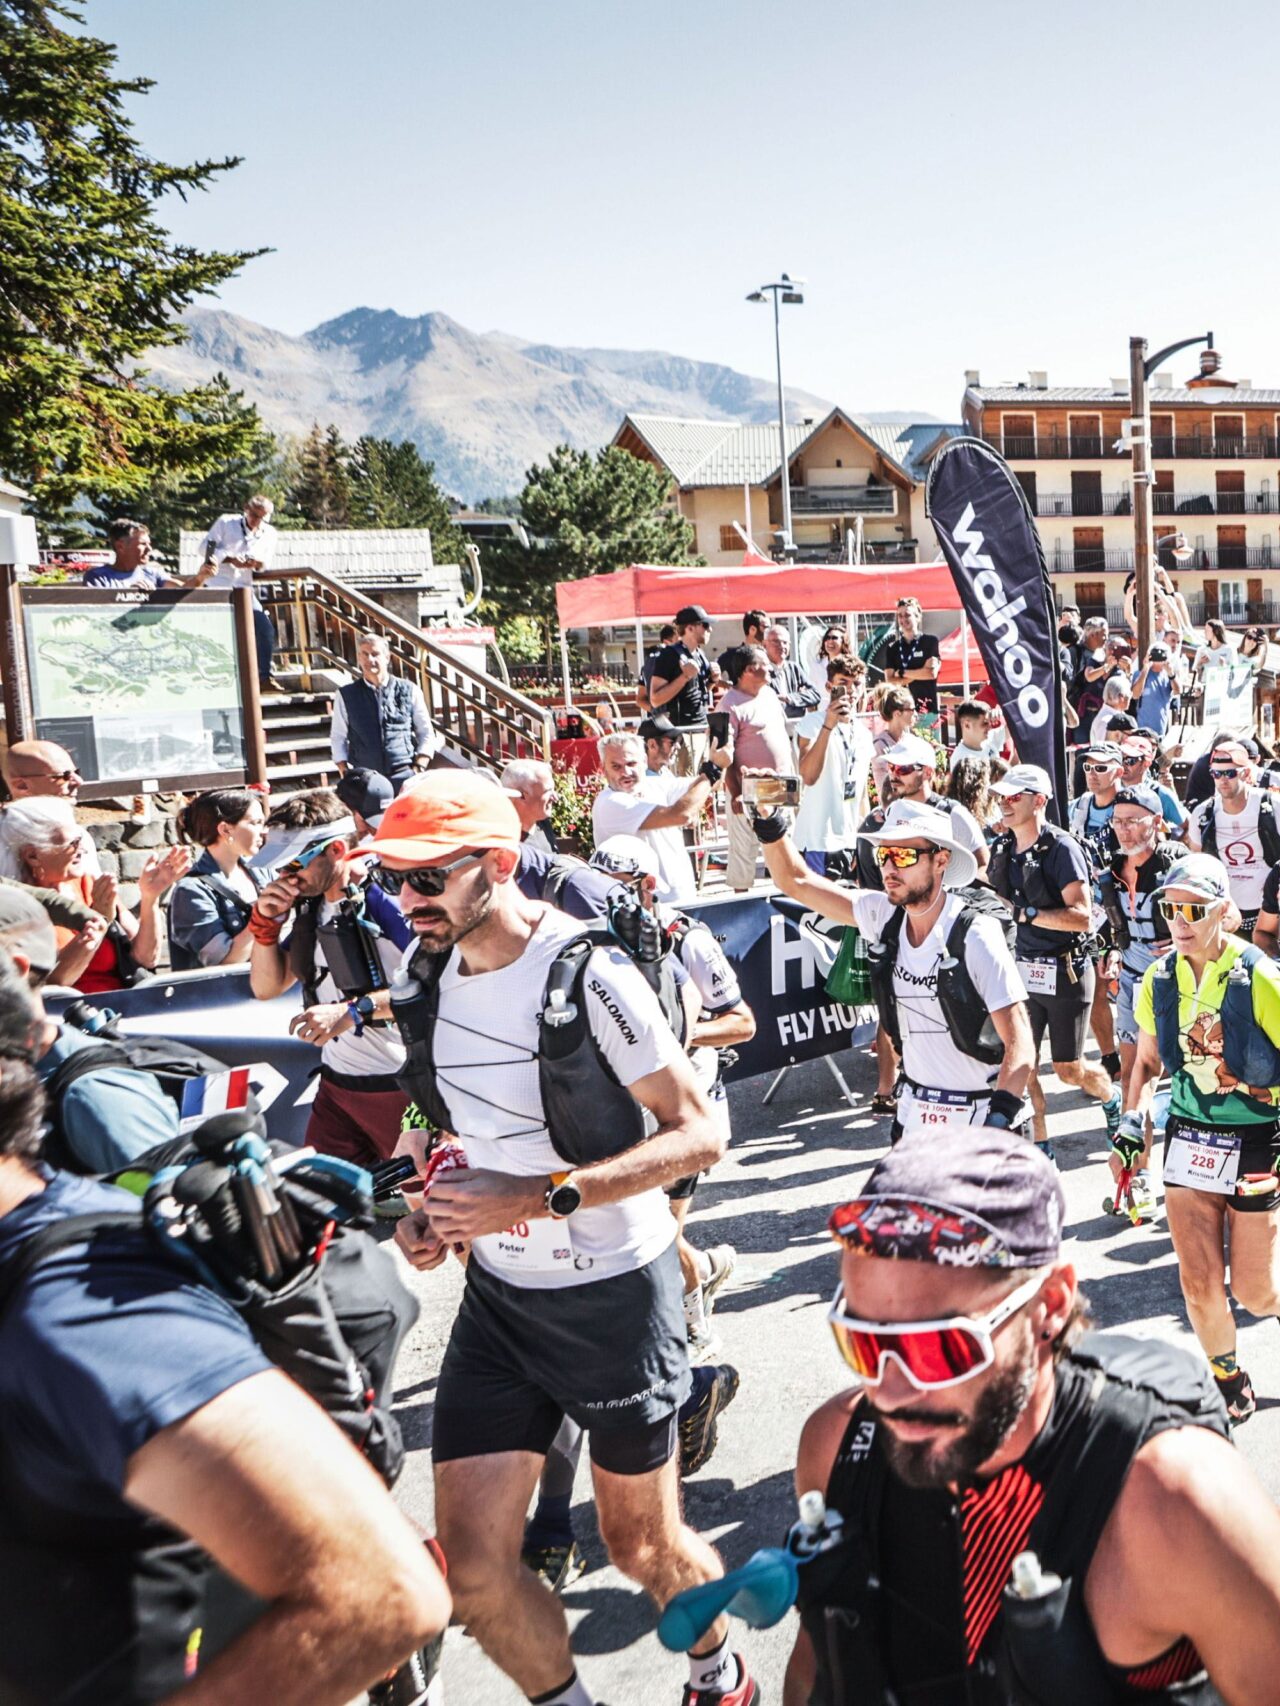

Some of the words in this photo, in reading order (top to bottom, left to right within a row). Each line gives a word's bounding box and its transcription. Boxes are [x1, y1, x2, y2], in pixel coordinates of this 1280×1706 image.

[115, 591, 150, 602] AURON
[952, 501, 1050, 729] wahoo
[1029, 970, 1046, 979] 352
[587, 979, 639, 1046] SALOMON
[776, 1008, 816, 1047] FLY
[920, 1112, 948, 1125] 193
[1187, 1143, 1201, 1153] NICE
[1190, 1153, 1216, 1170] 228
[498, 1241, 526, 1254] Peter
